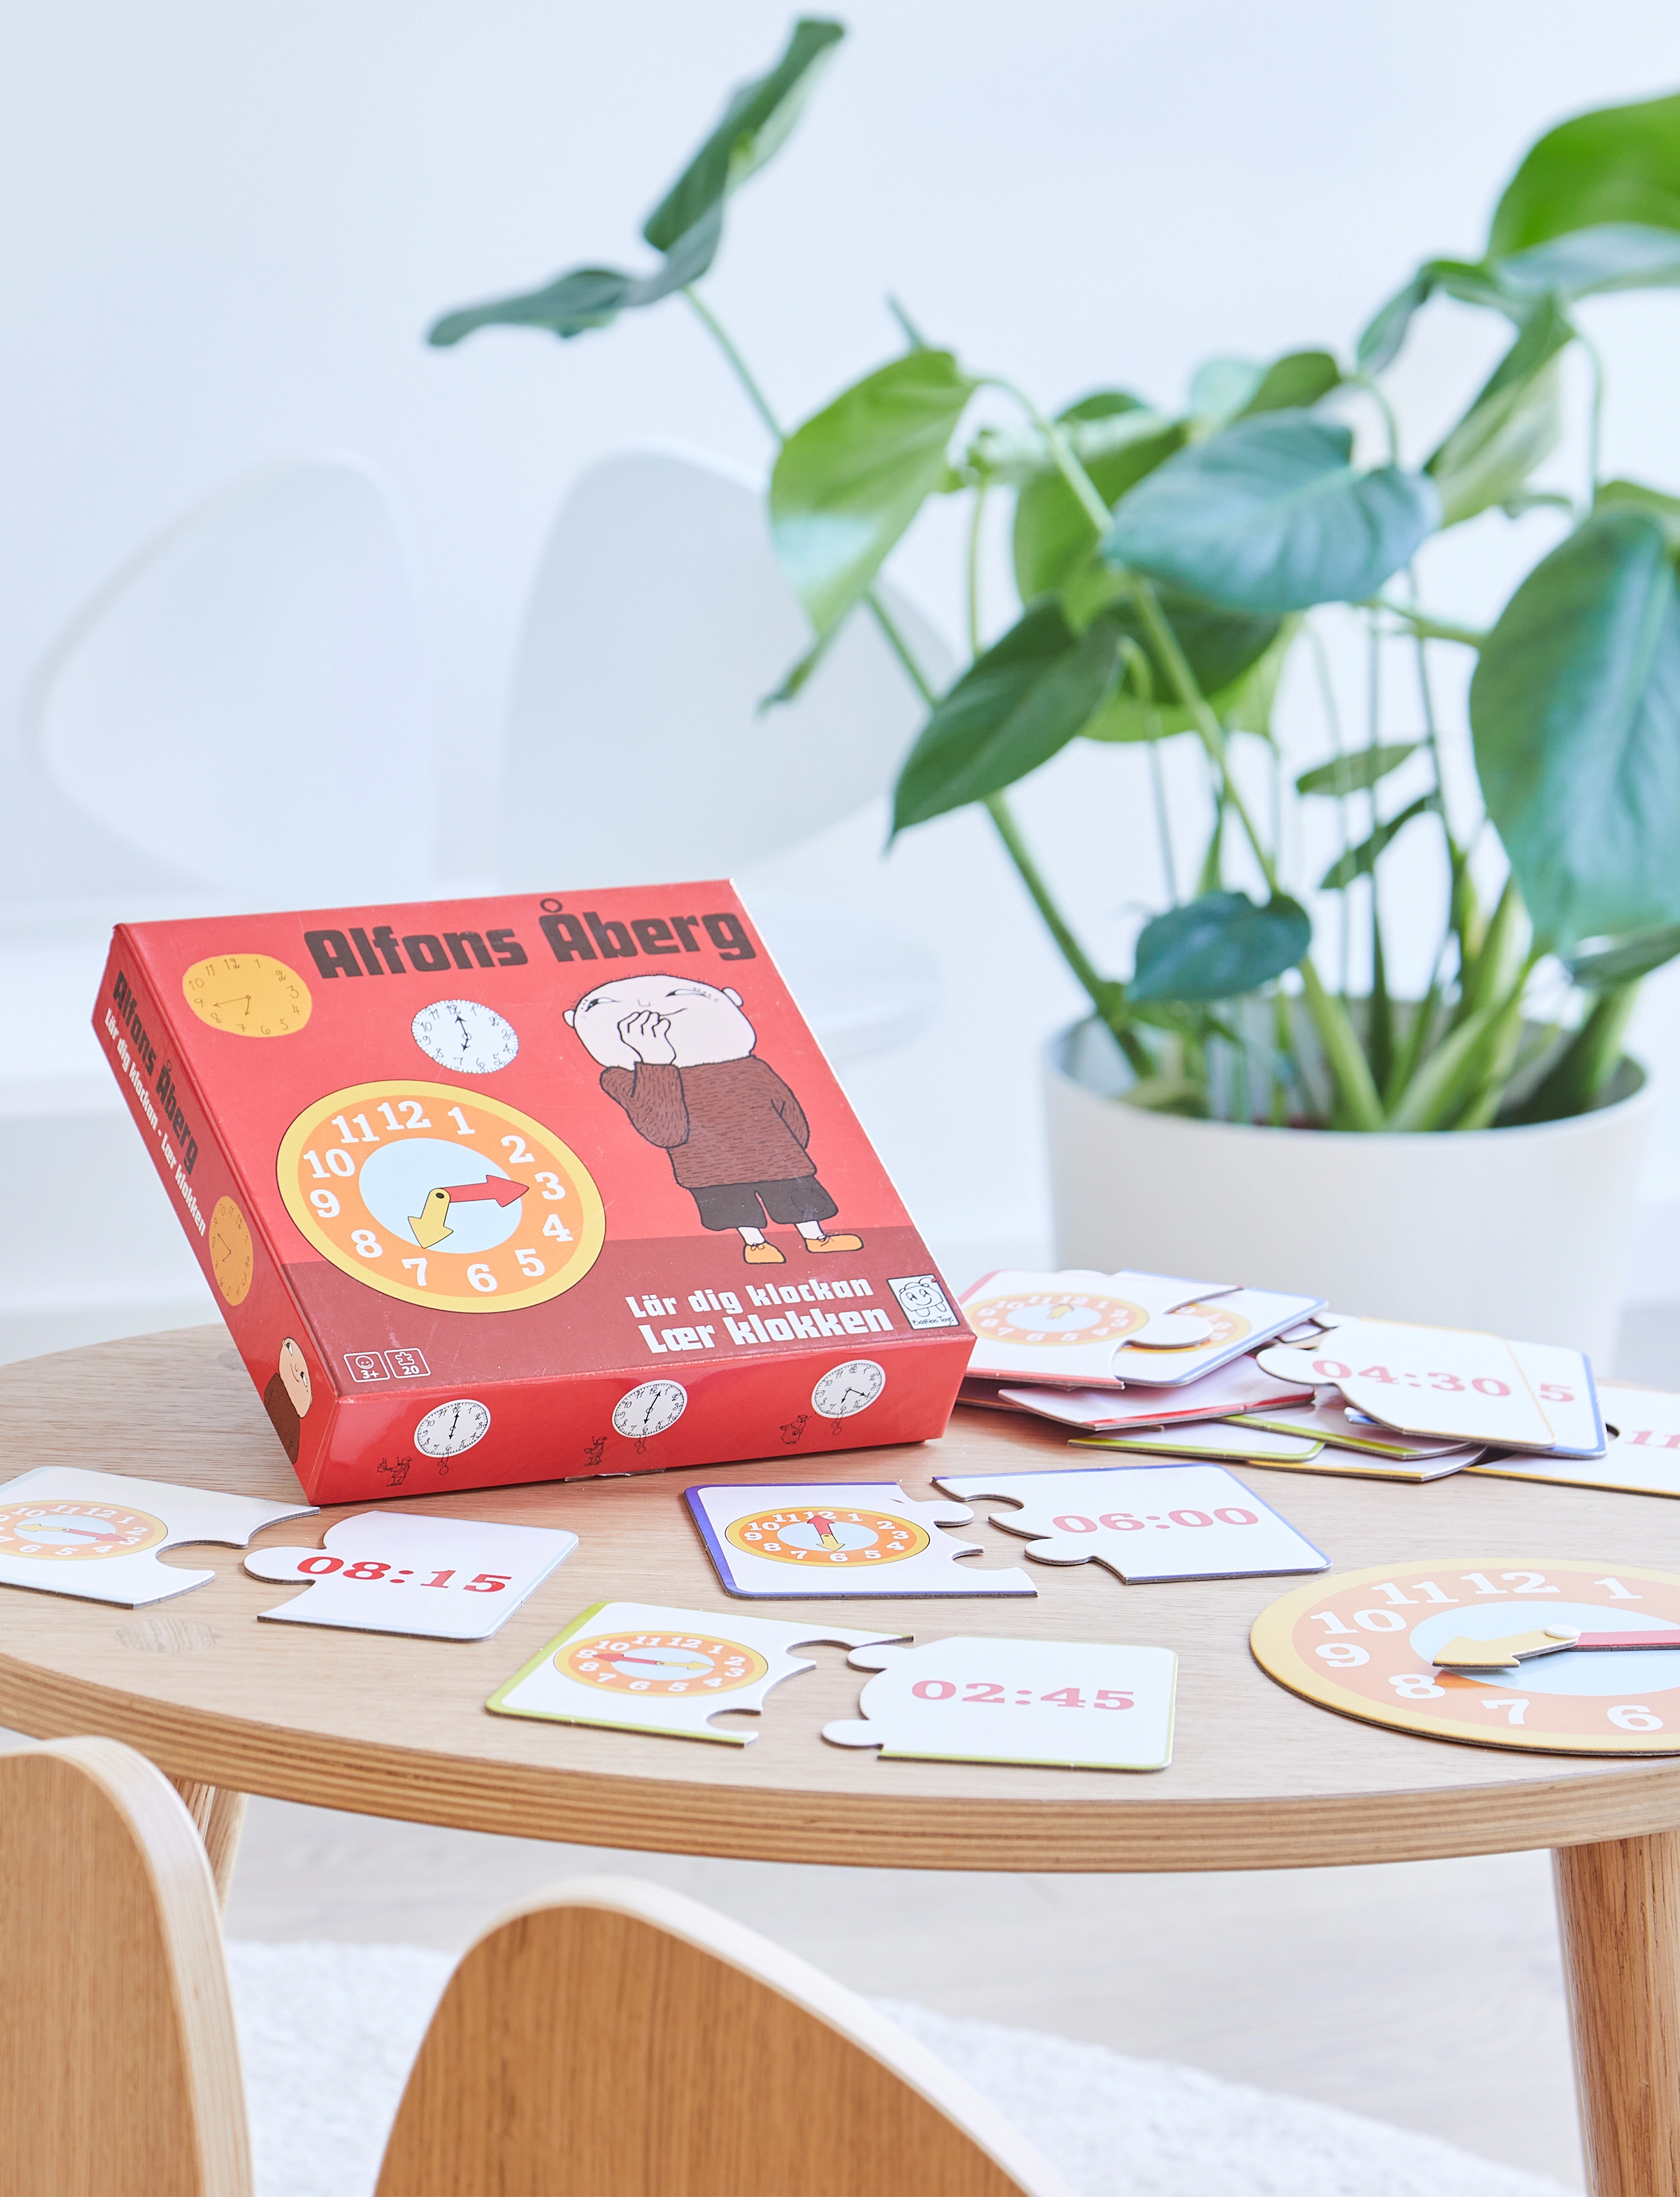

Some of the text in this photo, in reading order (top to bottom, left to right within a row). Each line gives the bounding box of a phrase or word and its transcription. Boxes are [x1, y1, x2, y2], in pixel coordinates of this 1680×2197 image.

[304, 898, 757, 979] Alfons Åberg
[189, 958, 300, 1035] 12 1 2 3 4 5 6 7 8 9 10 11
[420, 1004, 512, 1068] 12 1 2 3 4 5 6 7 8 9 10 11
[113, 970, 198, 1175] Alfons Åberg
[105, 1008, 206, 1237] Lär dig klockan Lær klokken
[304, 1101, 573, 1292] 12 1 2 3 4 5 6 7 8 9 10 11
[625, 1277, 874, 1318] Lär dig klockan
[638, 1308, 894, 1354] Lær klokken
[977, 1296, 1130, 1341] 12 1 2 3 4 5 6 7 8 9 10 11
[361, 1370, 379, 1379] 3+
[402, 1365, 420, 1375] 20
[1312, 1360, 1511, 1396] 04:30
[1540, 1383, 1575, 1402] 5
[12, 1508, 46, 1517] 10
[50, 1505, 80, 1514] 11
[83, 1508, 117, 1518] 12
[1053, 1508, 1259, 1533] 06:00
[125, 1527, 147, 1535] 2
[744, 1532, 762, 1540] 9
[55, 1547, 78, 1555] 5
[93, 1545, 113, 1553] 4
[830, 1553, 848, 1562] 6
[865, 1550, 881, 1559] 5
[297, 1556, 512, 1593] 08:15
[576, 1635, 745, 1692] 12 1 2 3 4 5 6 7 8 9 10 11
[1310, 1572, 1663, 1730] 12 1 6 7 8 9 10 11
[912, 1680, 1134, 1710] 02:45
